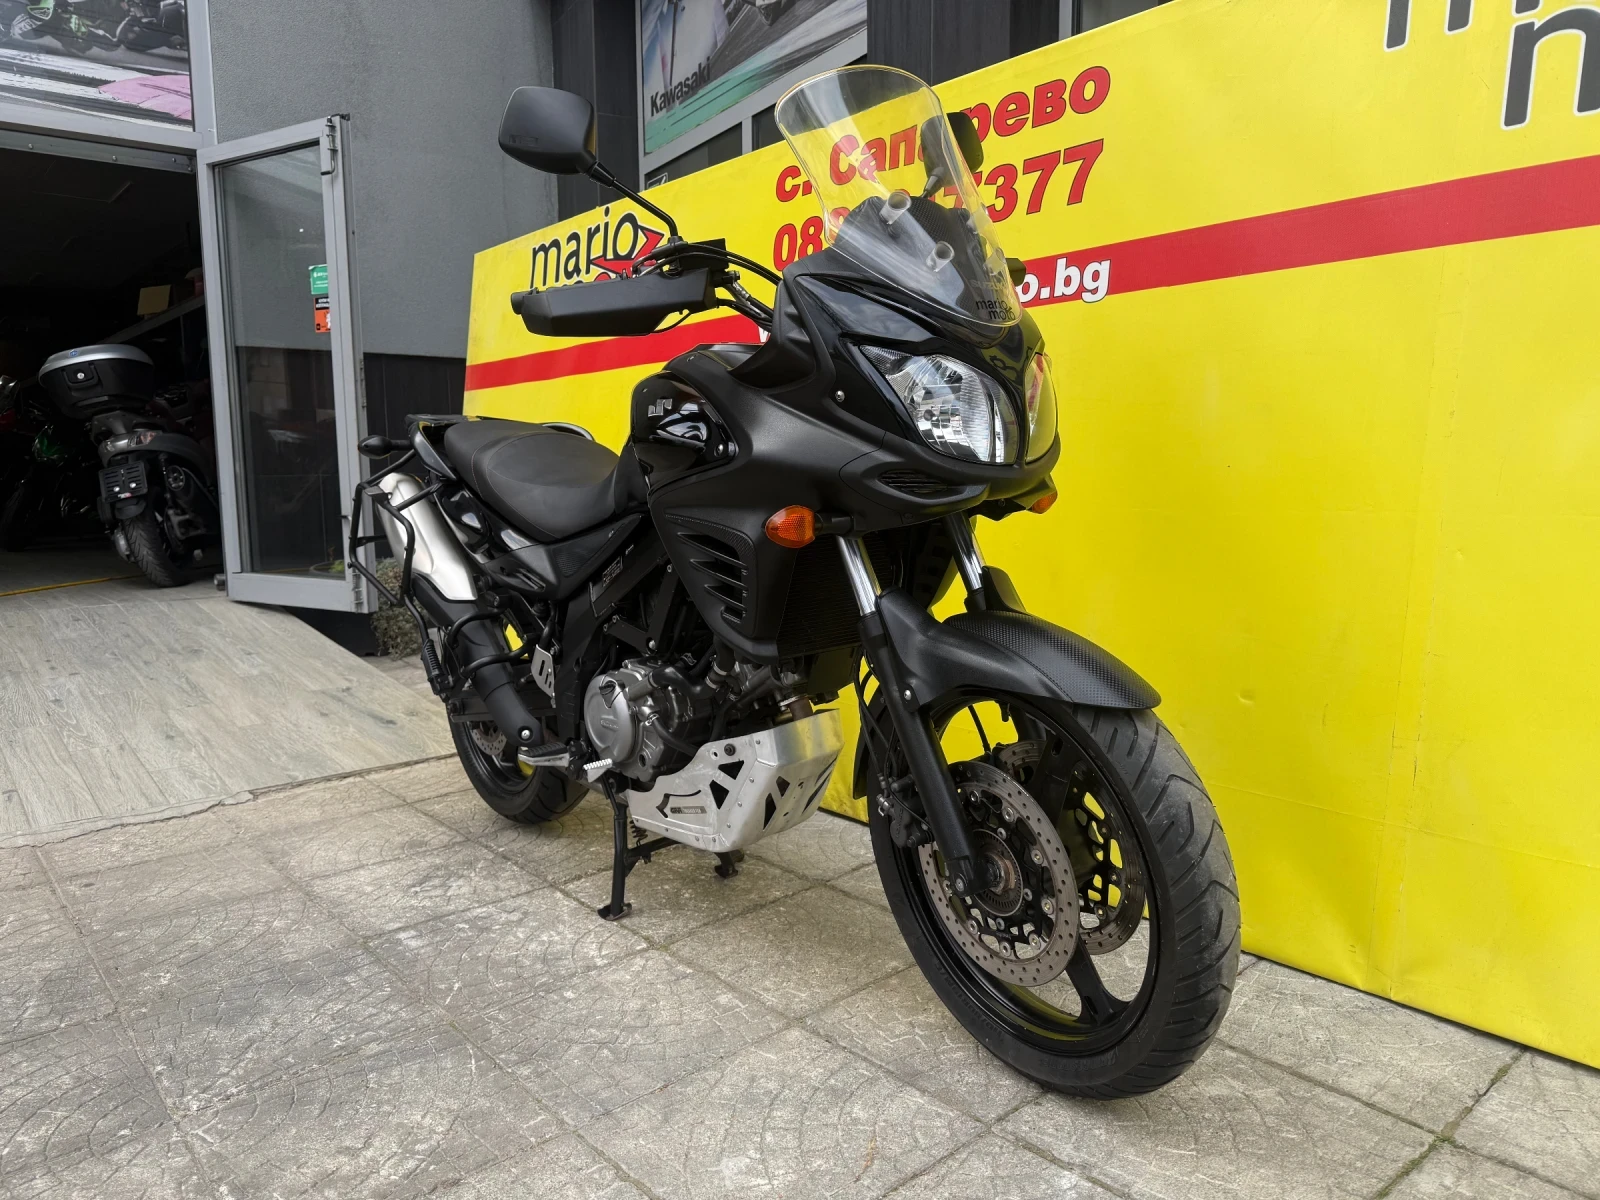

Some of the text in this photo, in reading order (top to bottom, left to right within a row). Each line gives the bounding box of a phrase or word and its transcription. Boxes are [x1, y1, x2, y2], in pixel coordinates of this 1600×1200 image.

[650, 56, 711, 117] Kawasaki
[829, 65, 1111, 186] Сапрево
[529, 206, 640, 289] mario
[975, 297, 1008, 310] mario
[988, 305, 1016, 321] moto
